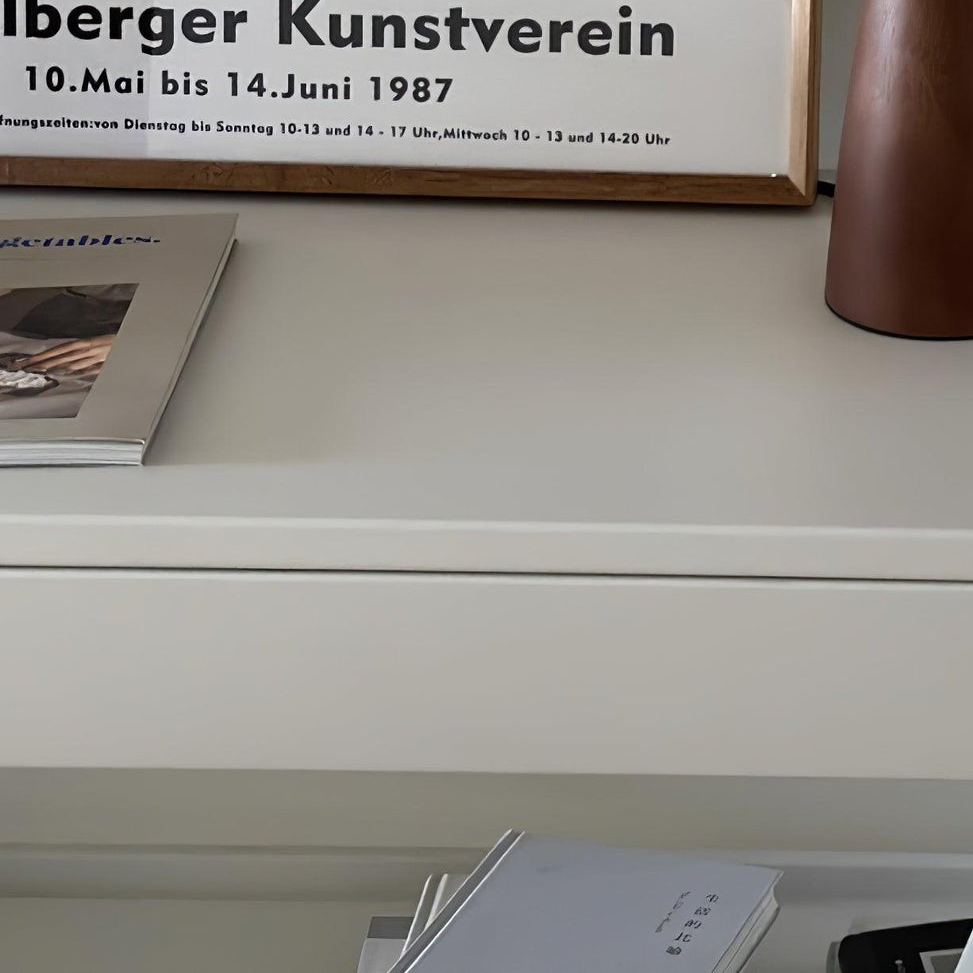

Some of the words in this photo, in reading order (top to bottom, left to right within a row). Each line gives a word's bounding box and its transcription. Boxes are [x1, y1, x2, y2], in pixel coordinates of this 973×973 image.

[25, 65, 144, 94] 10.Mai
[161, 69, 209, 97] bis
[227, 71, 351, 100] 14.Juni
[369, 76, 454, 103] 1987
[124, 117, 186, 134] Dienstag
[191, 119, 211, 132] bis
[216, 120, 274, 137] Sonntag
[280, 122, 320, 136] 10-13
[325, 124, 351, 137] und
[568, 132, 594, 144] und
[600, 132, 640, 145] 14-20
[645, 132, 671, 146] Uhr
